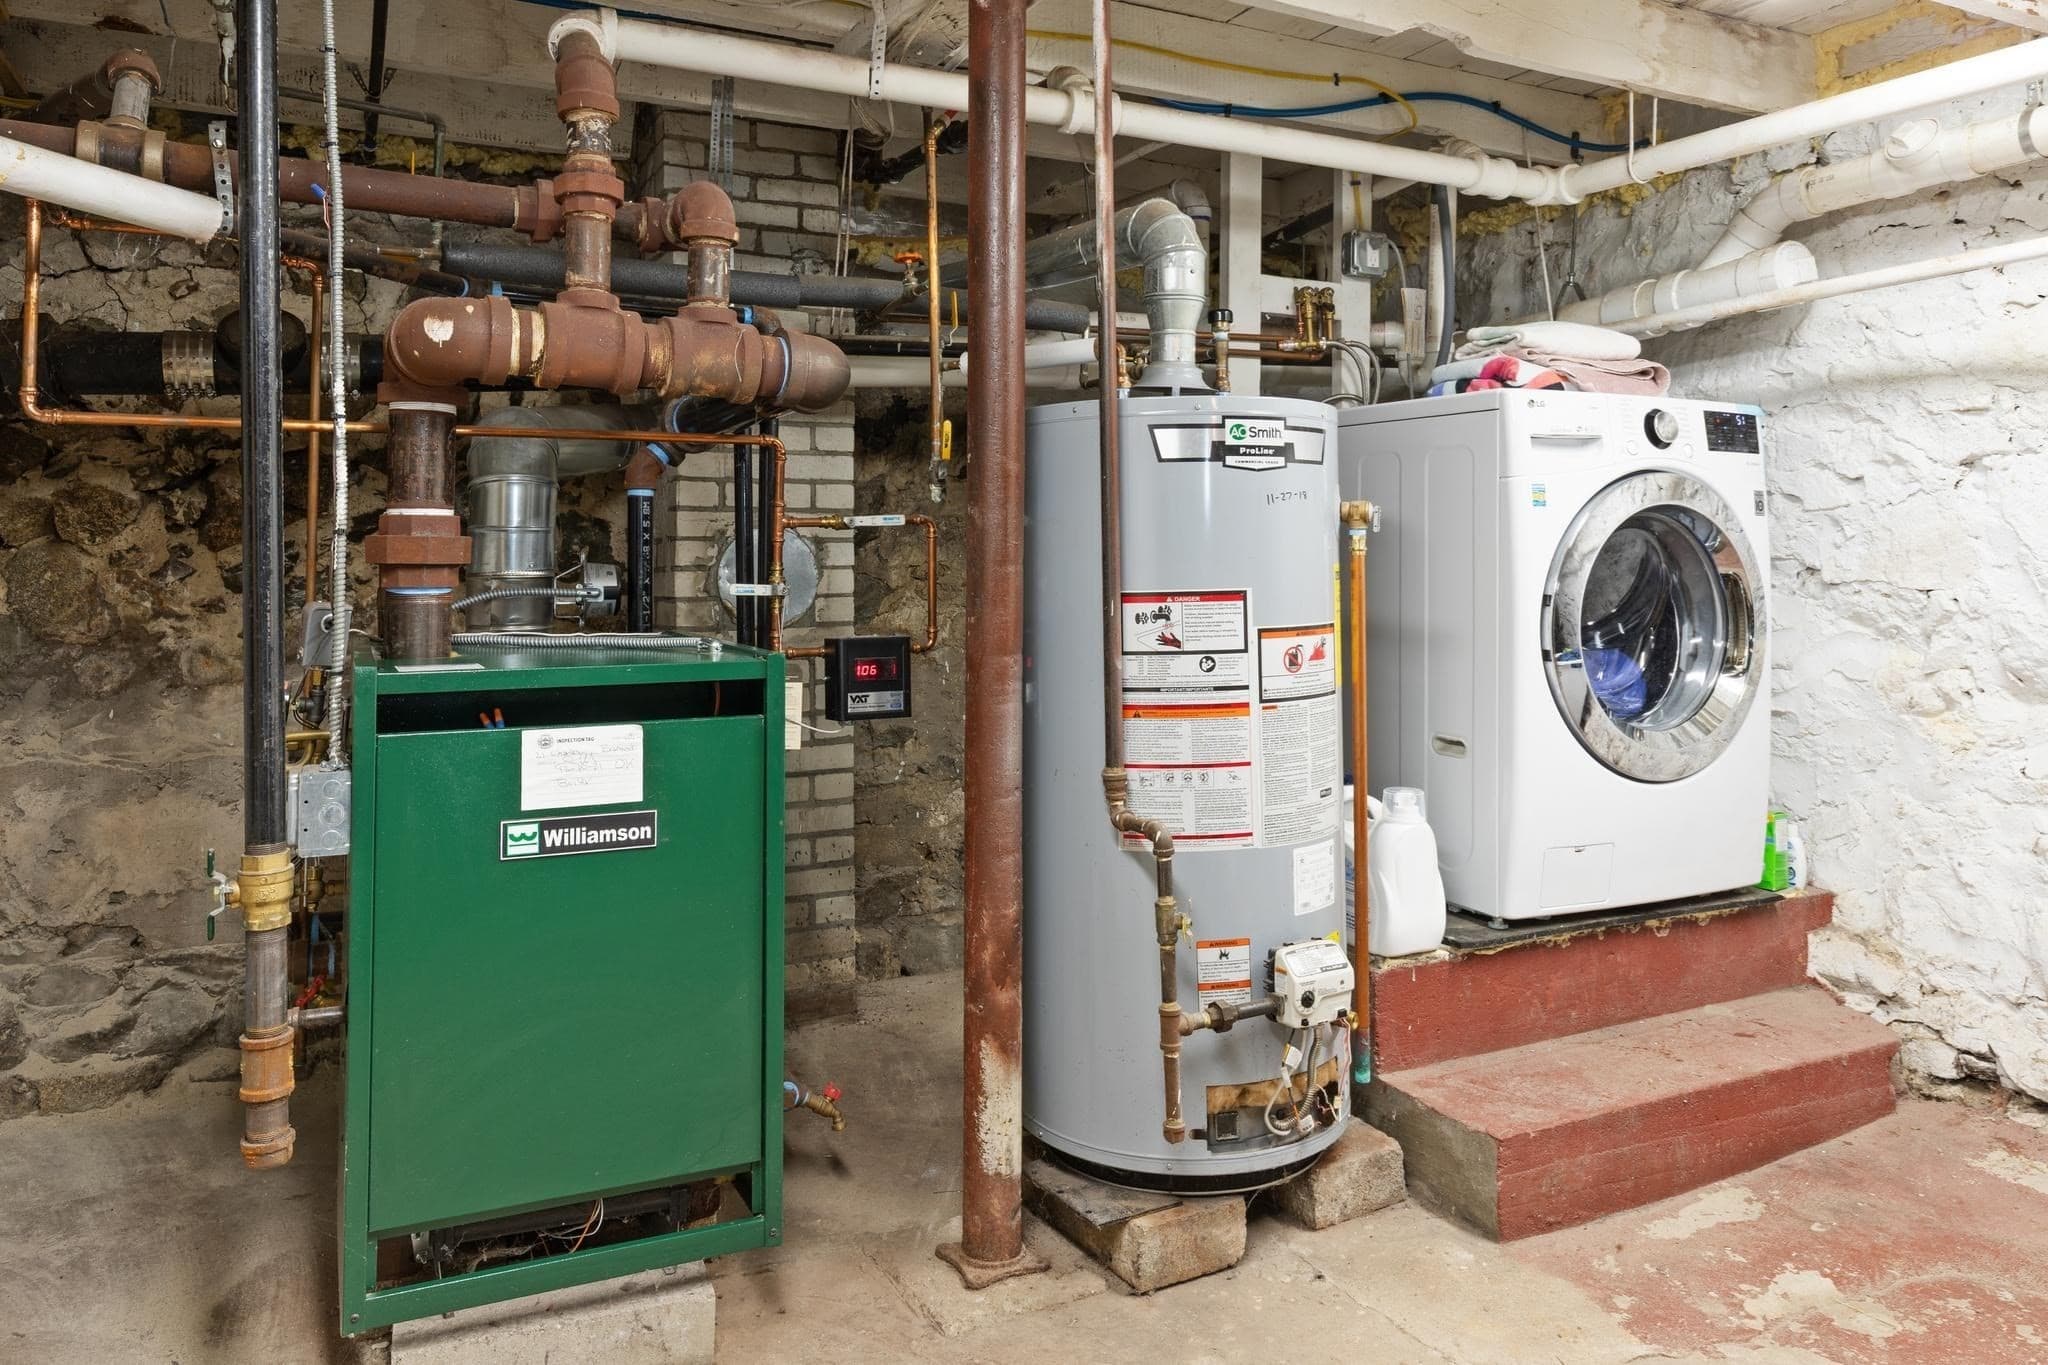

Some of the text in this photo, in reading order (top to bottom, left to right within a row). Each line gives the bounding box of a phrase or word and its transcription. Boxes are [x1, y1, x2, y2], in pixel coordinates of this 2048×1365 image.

[1248, 426, 1282, 439] Smith
[1239, 446, 1275, 455] ProLine
[855, 664, 878, 676] 106
[849, 694, 870, 704] VXT
[543, 824, 652, 848] Williamson
